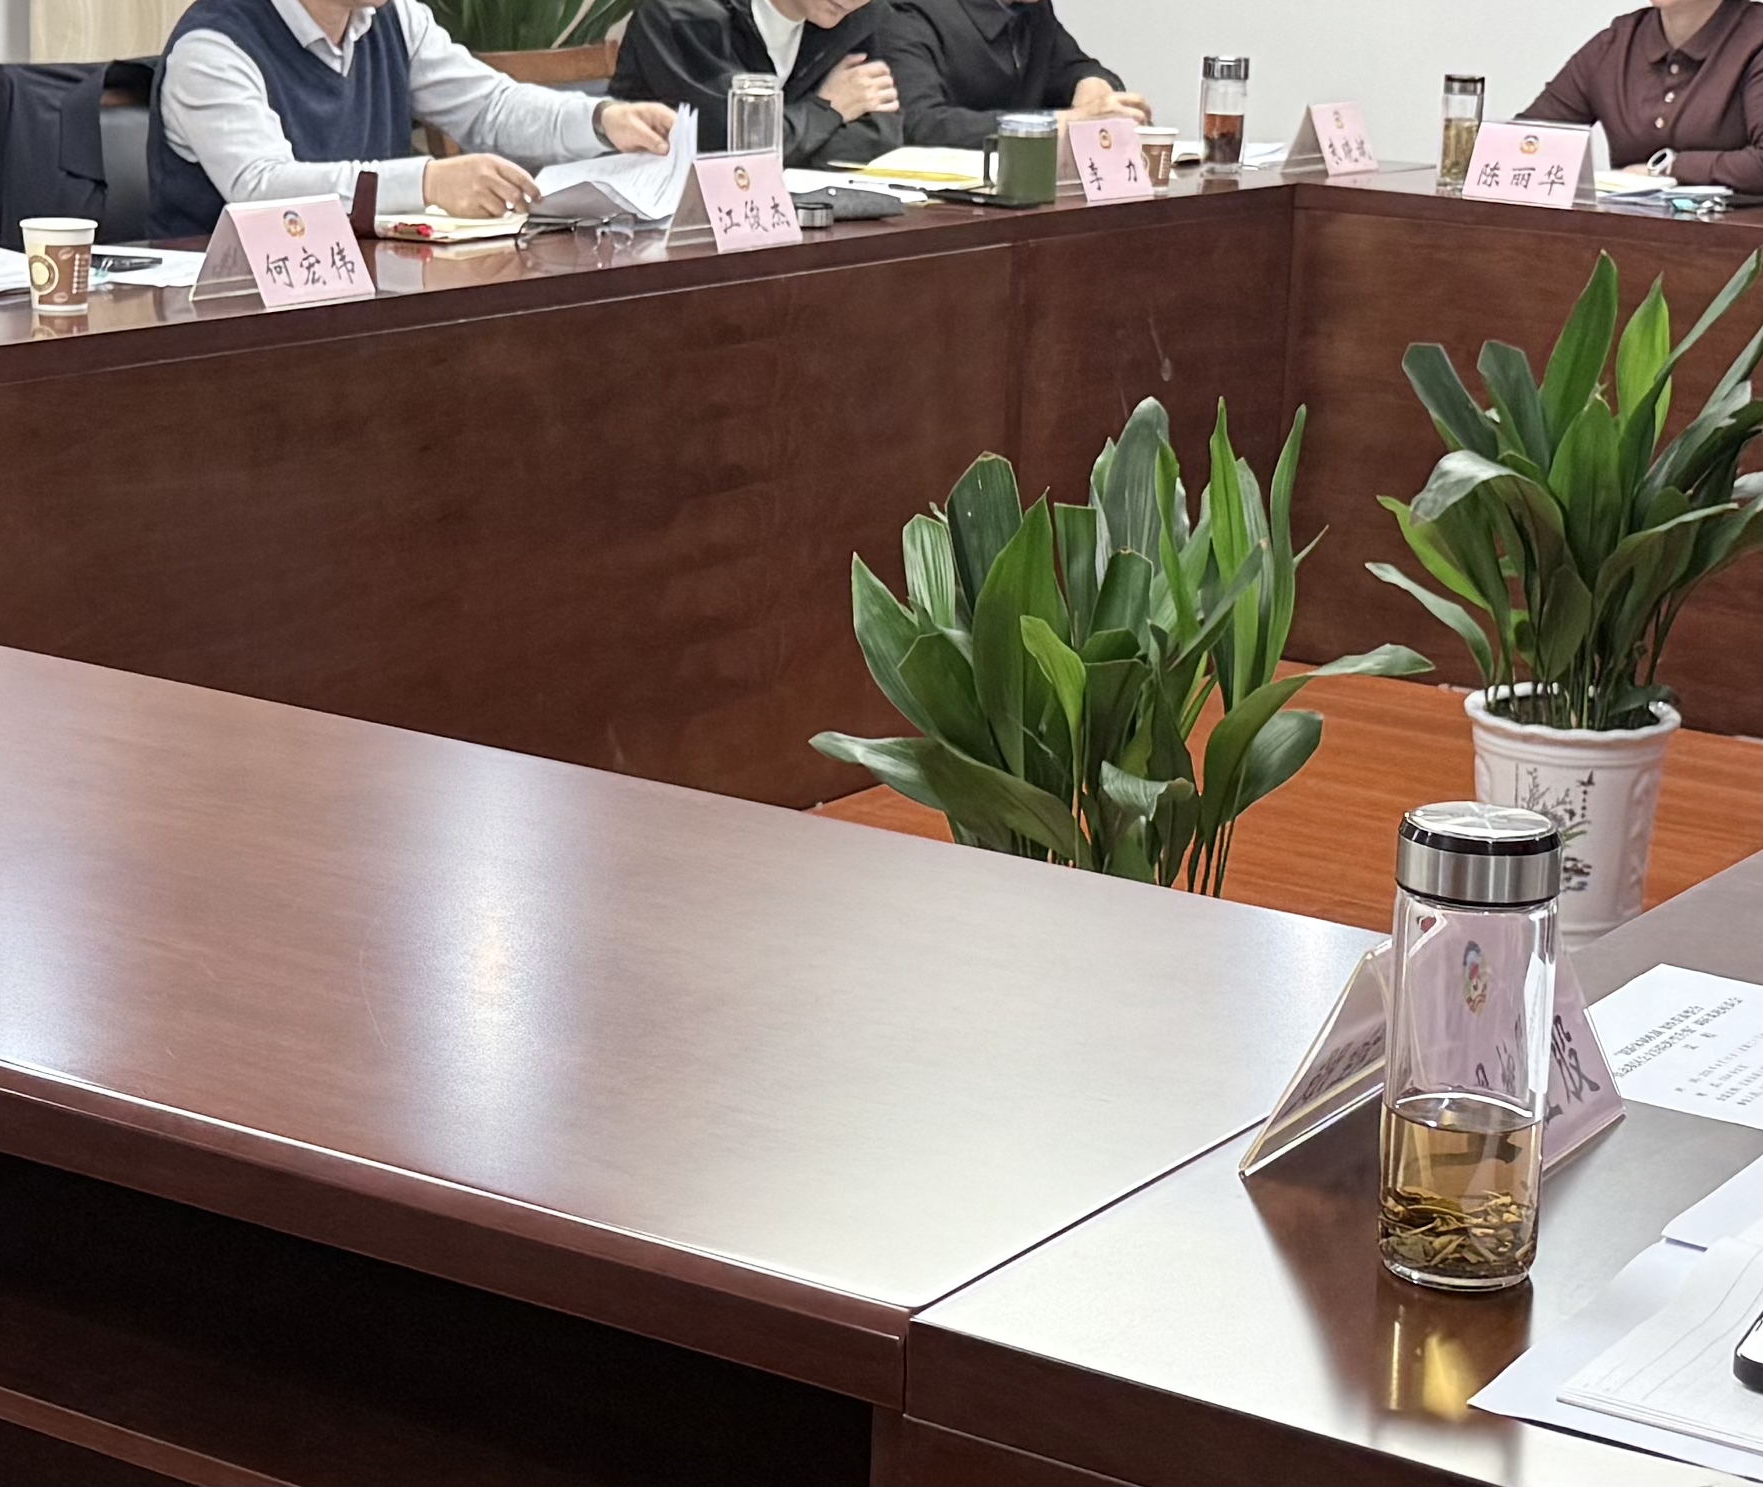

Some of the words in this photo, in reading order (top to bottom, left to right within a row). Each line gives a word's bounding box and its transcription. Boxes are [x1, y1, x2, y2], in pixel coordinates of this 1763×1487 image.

[1476, 161, 1566, 197] 陈丽华
[265, 241, 356, 289] 何宏伟
